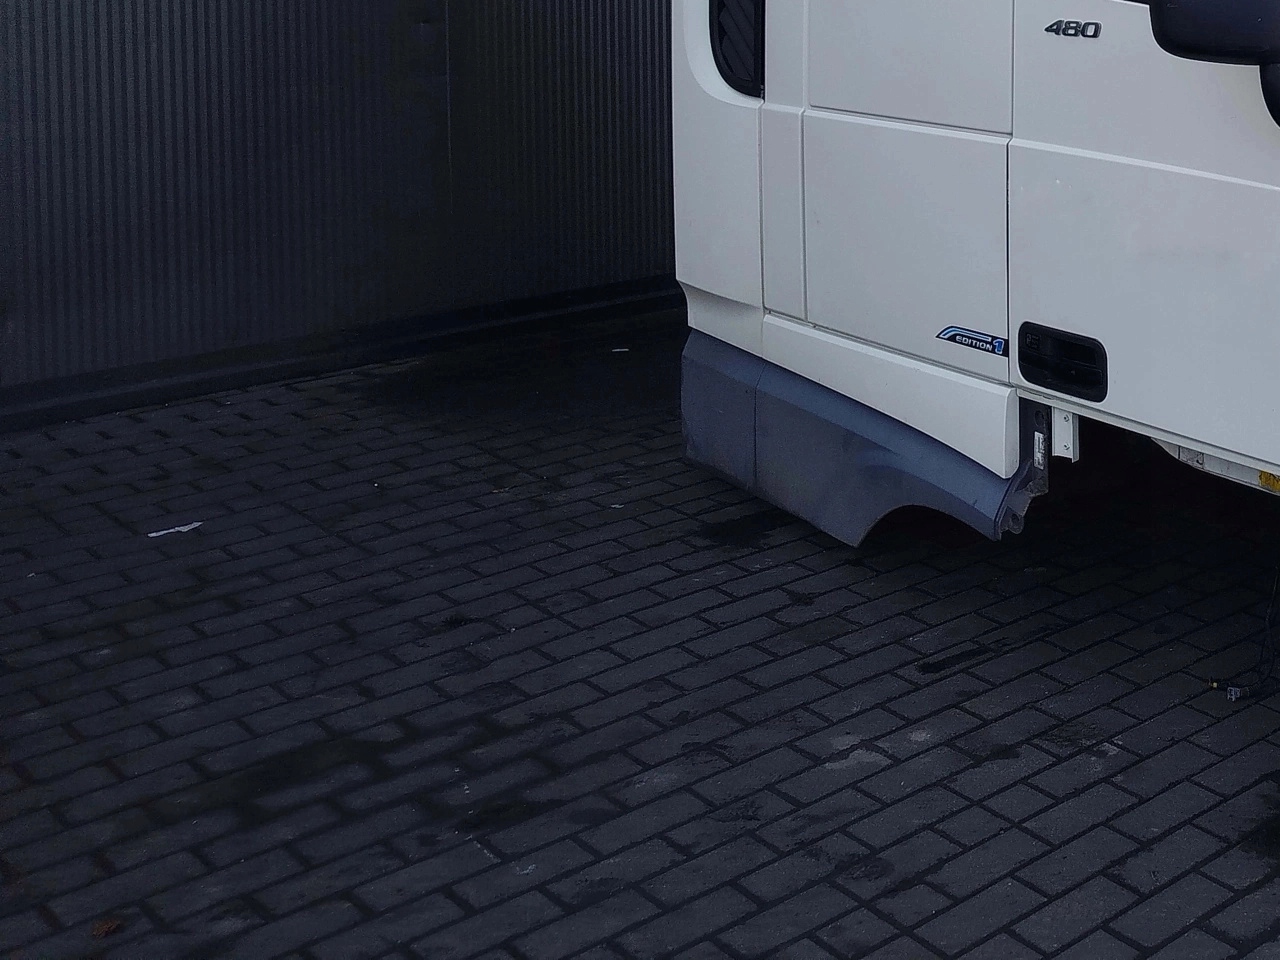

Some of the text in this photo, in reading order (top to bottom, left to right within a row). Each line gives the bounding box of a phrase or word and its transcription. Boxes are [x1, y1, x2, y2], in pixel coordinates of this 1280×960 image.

[1044, 18, 1102, 39] 480
[955, 335, 1005, 354] EDITION 1
